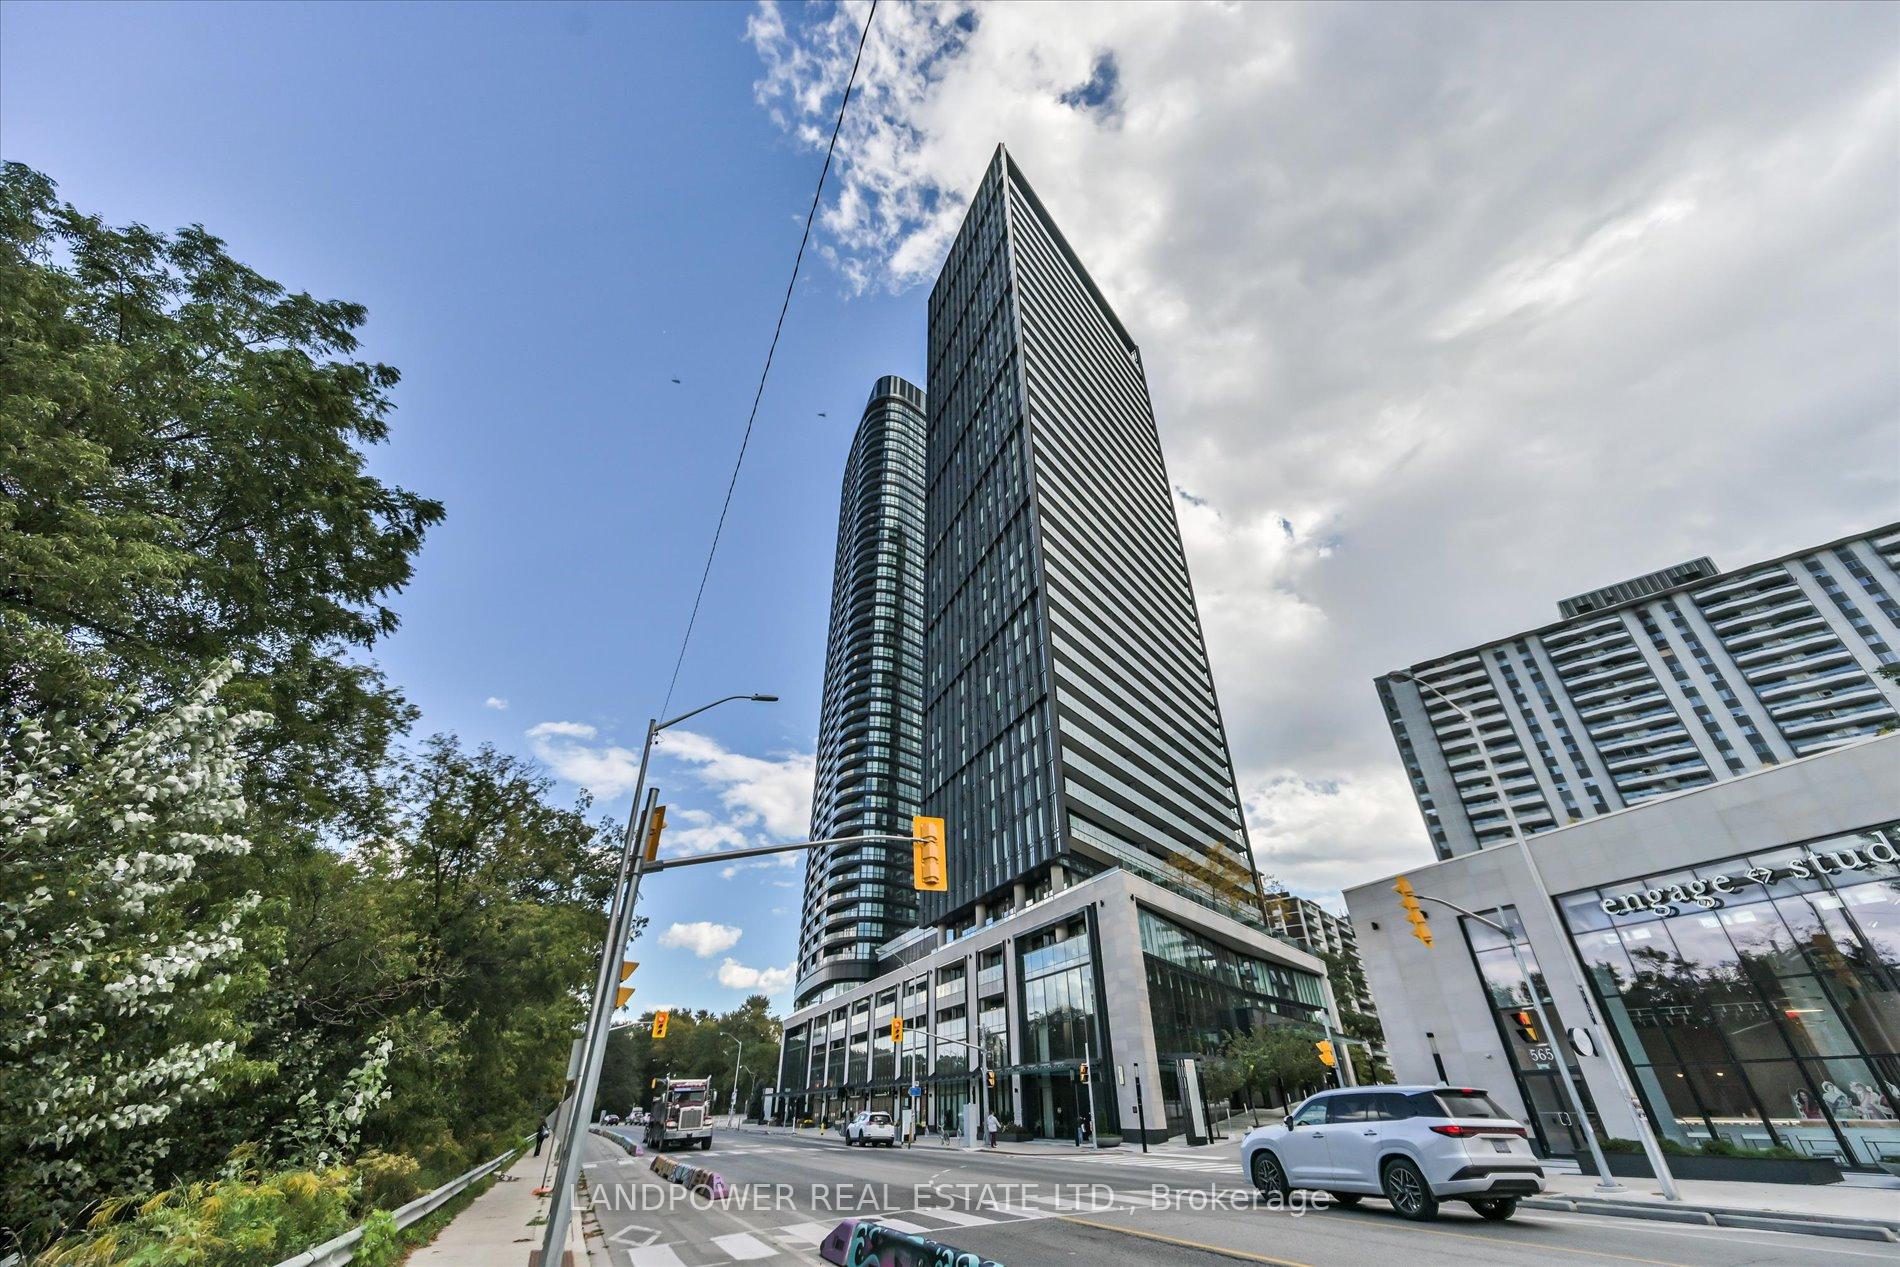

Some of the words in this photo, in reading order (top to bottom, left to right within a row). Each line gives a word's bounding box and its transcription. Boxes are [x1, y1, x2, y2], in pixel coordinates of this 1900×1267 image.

[1602, 876, 1735, 917] engage
[1787, 830, 1900, 880] stud
[1529, 1048, 1554, 1061] 565
